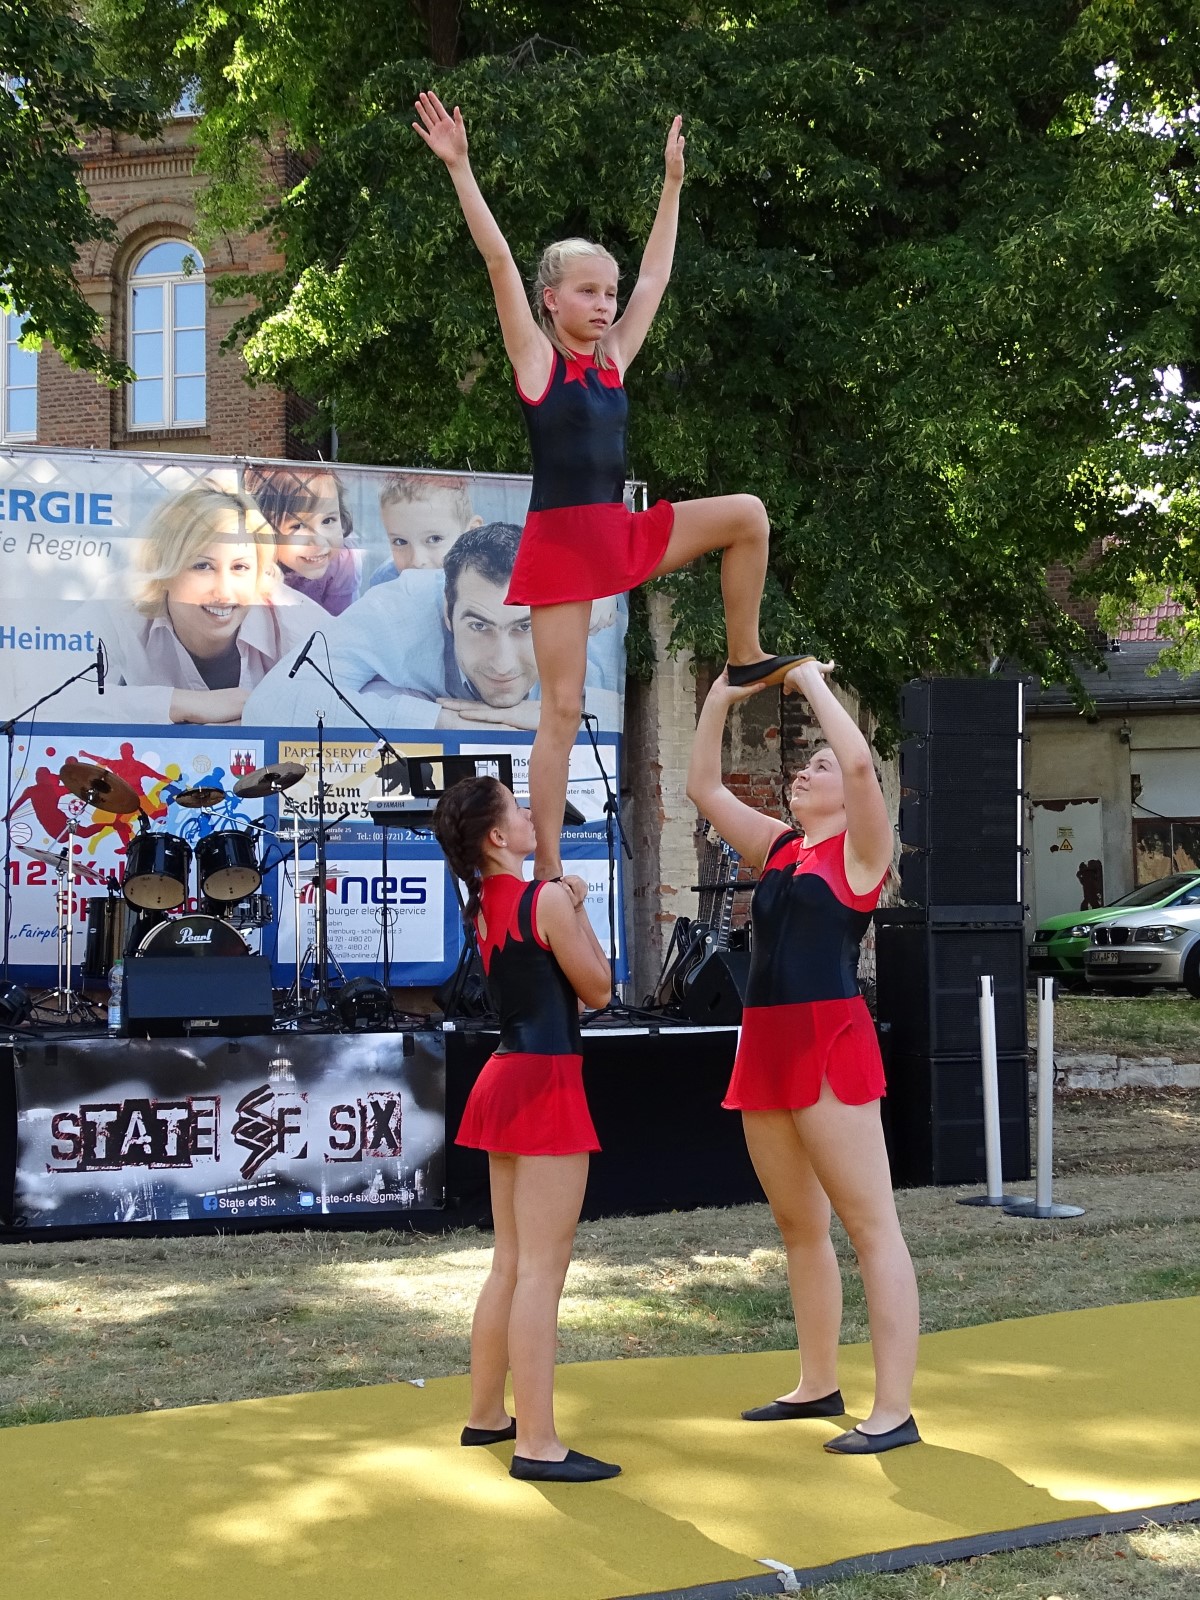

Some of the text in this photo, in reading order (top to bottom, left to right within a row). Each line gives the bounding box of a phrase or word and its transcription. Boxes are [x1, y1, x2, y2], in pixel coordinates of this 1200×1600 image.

[0, 488, 113, 525] RGIE
[27, 533, 112, 560] Region
[0, 626, 94, 651] Heimat
[324, 782, 361, 797] Zum
[405, 830, 412, 840] 2
[342, 877, 427, 904] nes
[395, 906, 426, 915] service
[175, 927, 212, 944] Pearl
[48, 1099, 220, 1171] STATE
[326, 1093, 402, 1162] SIX
[219, 1197, 245, 1209] State
[248, 1196, 257, 1206] of
[259, 1195, 276, 1207] Six
